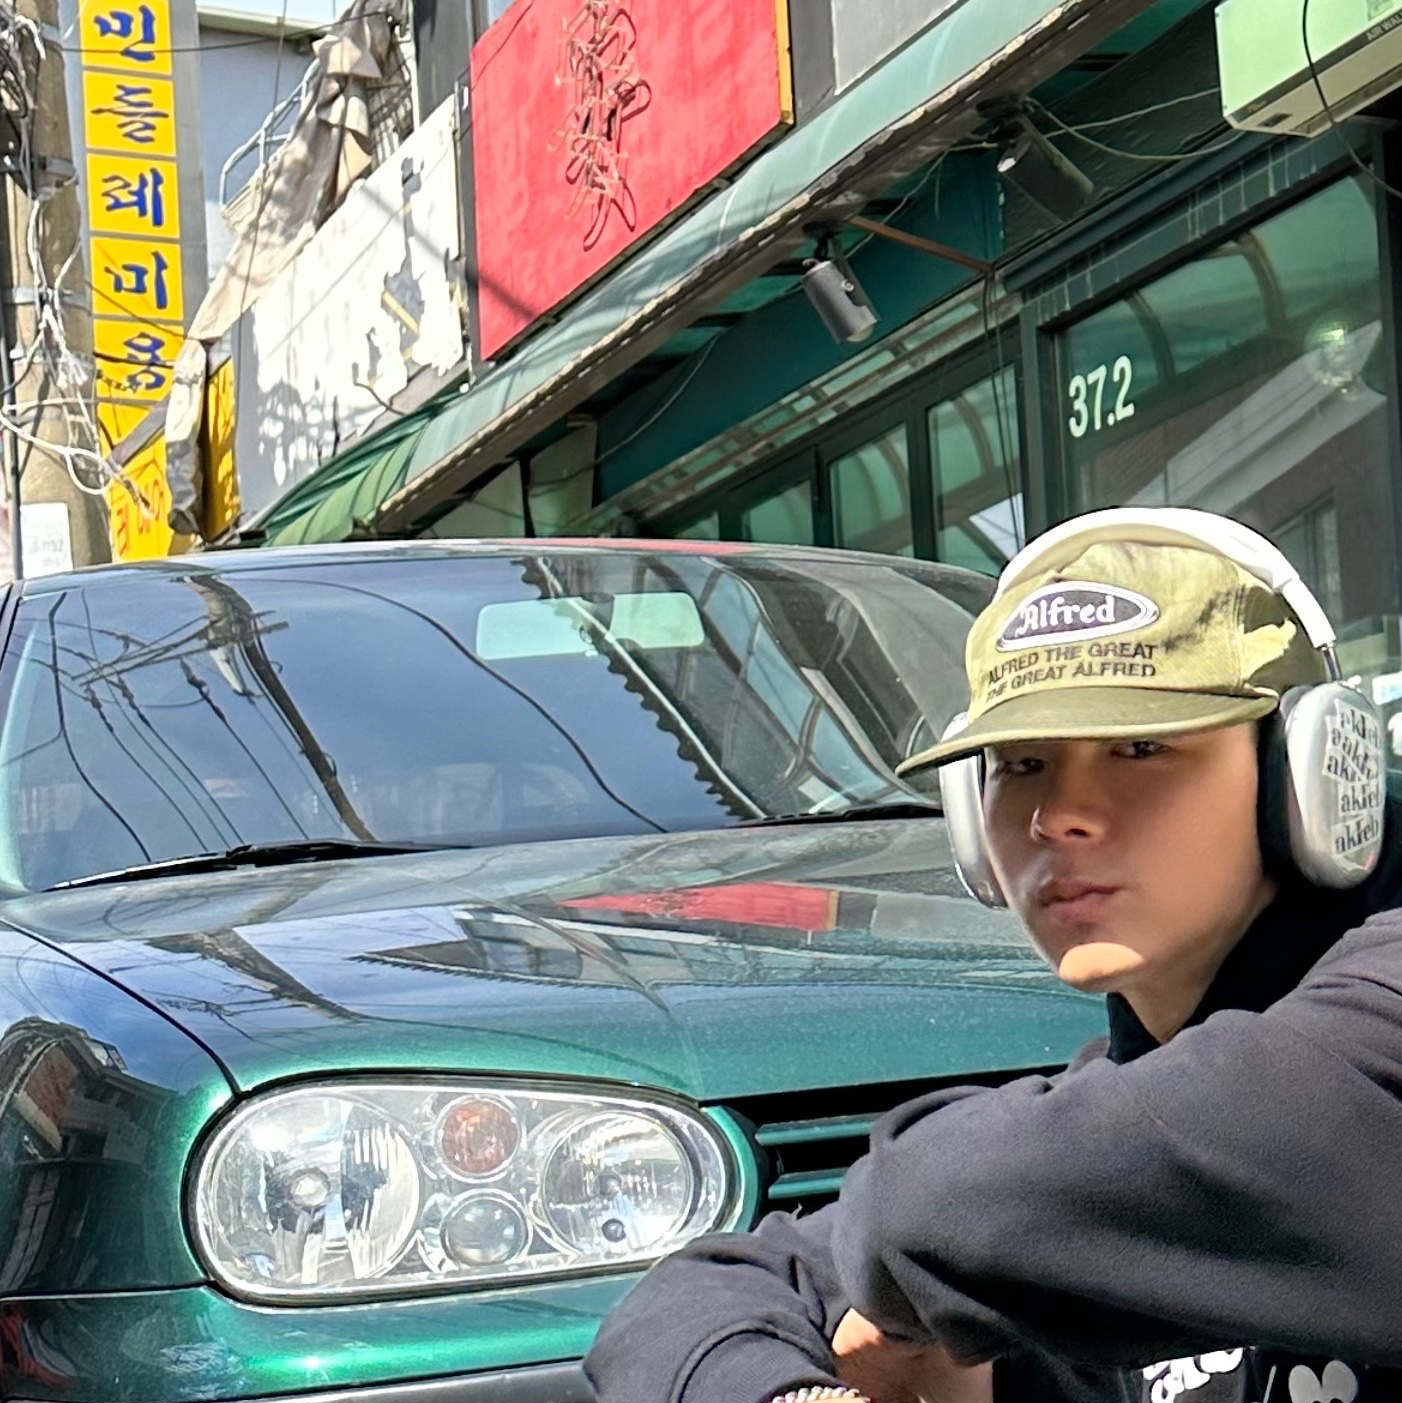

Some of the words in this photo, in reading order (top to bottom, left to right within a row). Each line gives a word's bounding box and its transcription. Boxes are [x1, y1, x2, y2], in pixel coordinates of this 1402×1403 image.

[1366, 26, 1383, 41] AIR
[1069, 355, 1135, 437] 37.2
[1015, 595, 1117, 638] Alfred
[988, 652, 1039, 686] ALFRED
[1044, 644, 1083, 662] THE
[1088, 641, 1158, 660] GREAT
[1011, 664, 1068, 691] GREAT
[1072, 660, 1156, 679] ALFRED
